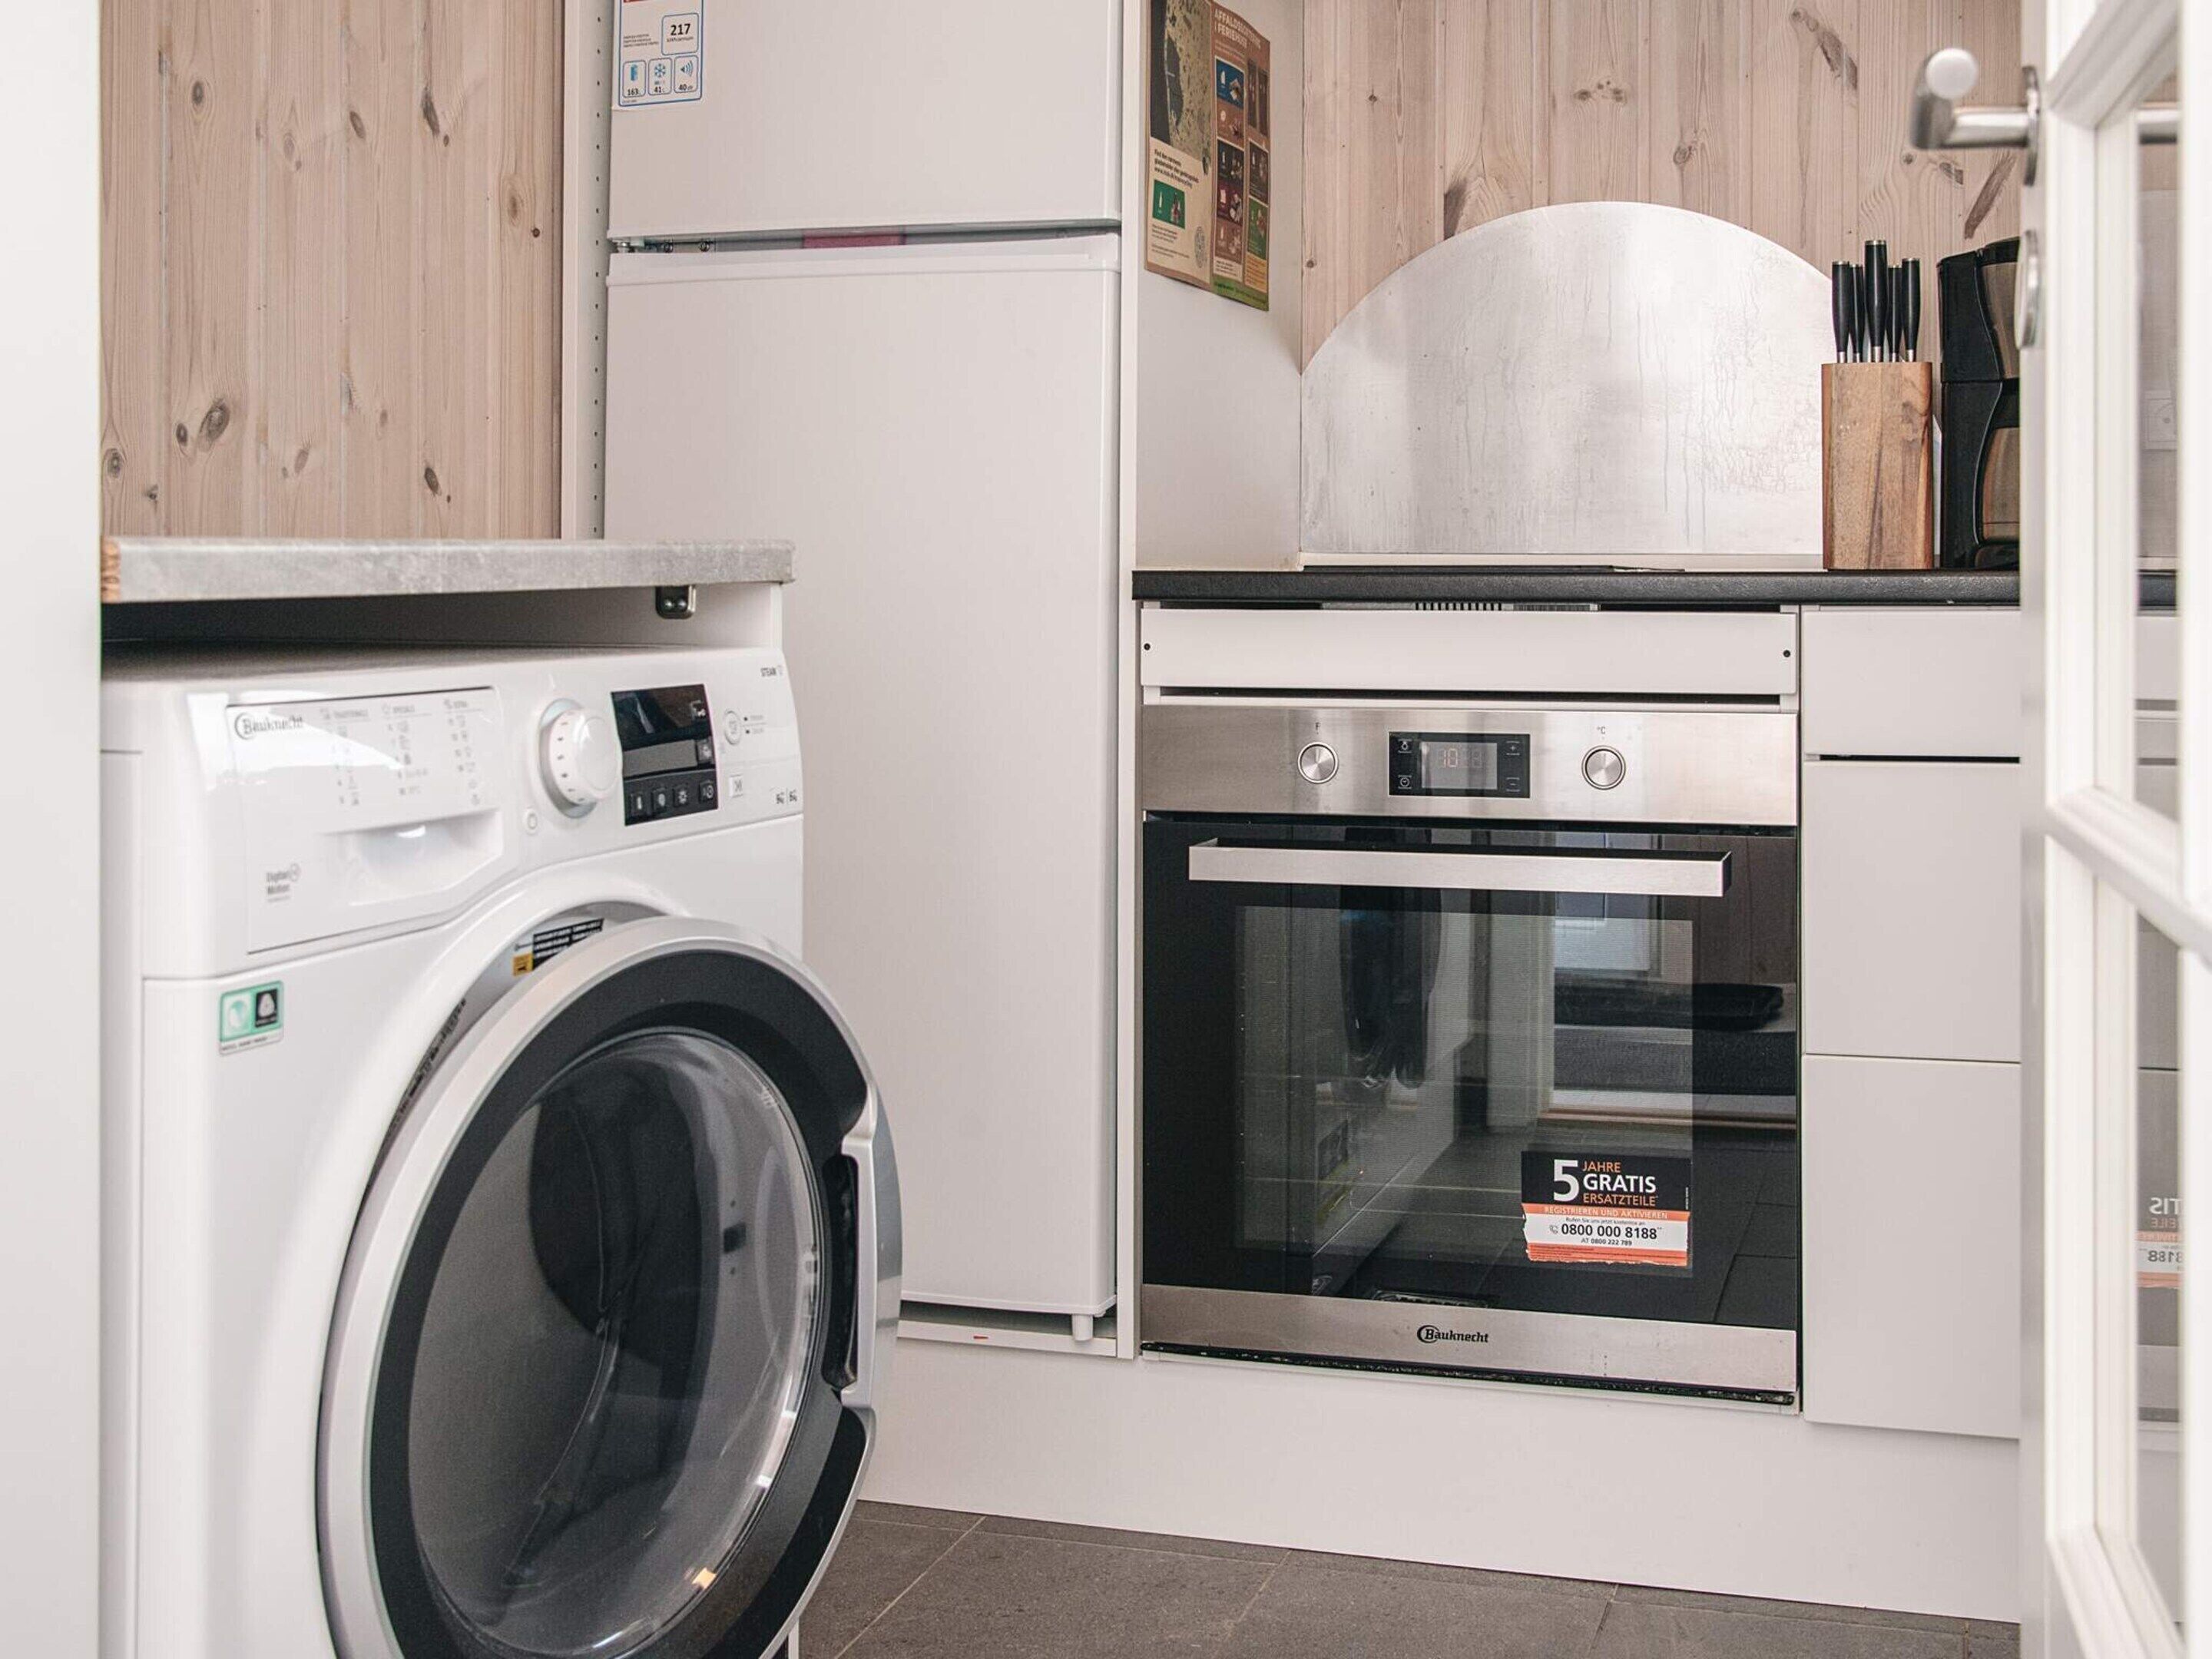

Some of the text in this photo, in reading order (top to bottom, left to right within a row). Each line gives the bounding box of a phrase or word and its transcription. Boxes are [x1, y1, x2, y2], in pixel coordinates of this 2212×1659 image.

[671, 23, 690, 35] 217
[1582, 1161, 1621, 1174] JAHRE
[1553, 1159, 1580, 1202] 5
[1583, 1173, 1657, 1194] GRATIS
[1582, 1193, 1657, 1207] ERSATZTEILE
[1545, 1206, 1668, 1219] REGISTRIEREN UND AKTIVIEREN
[1561, 1224, 1657, 1240] 0800 000 8188
[1417, 1325, 1488, 1343] Bauknecht
